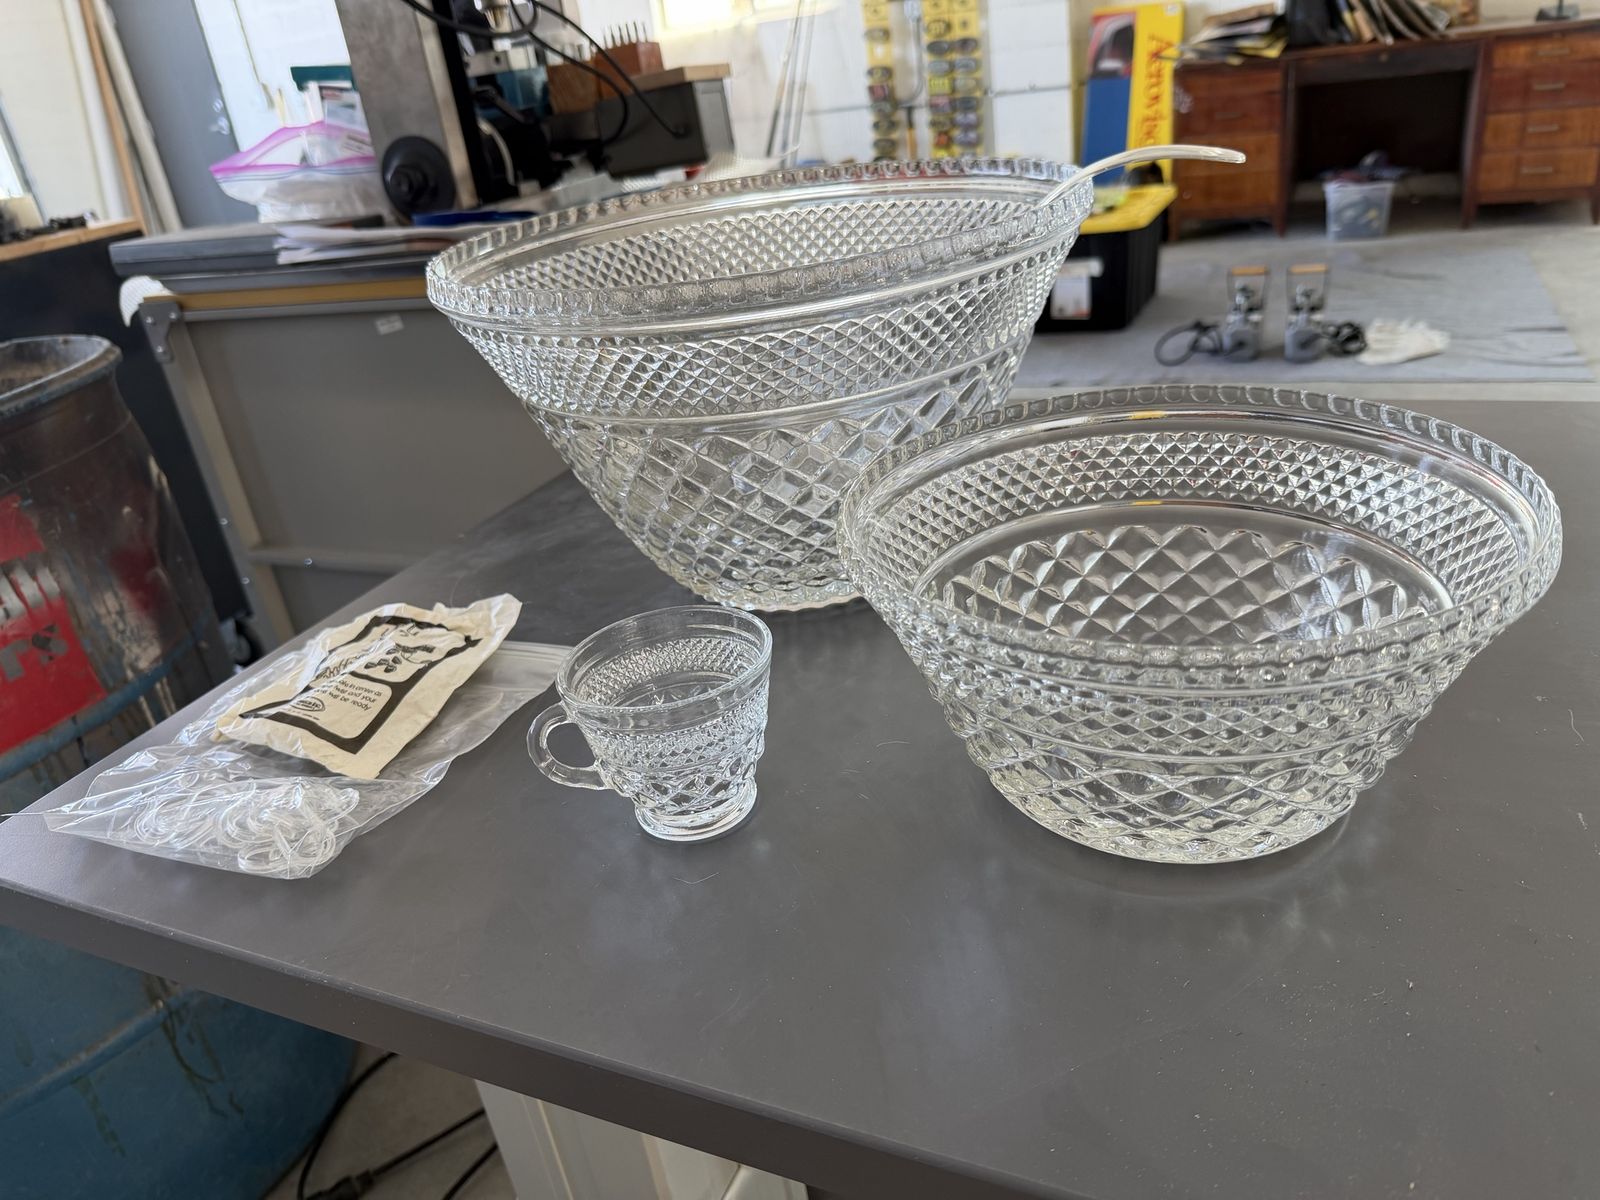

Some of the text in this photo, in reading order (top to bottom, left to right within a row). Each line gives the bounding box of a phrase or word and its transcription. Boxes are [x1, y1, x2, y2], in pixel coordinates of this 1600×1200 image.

[355, 685, 374, 694] center
[348, 690, 363, 698] and
[361, 694, 377, 704] your
[350, 699, 372, 711] ready
